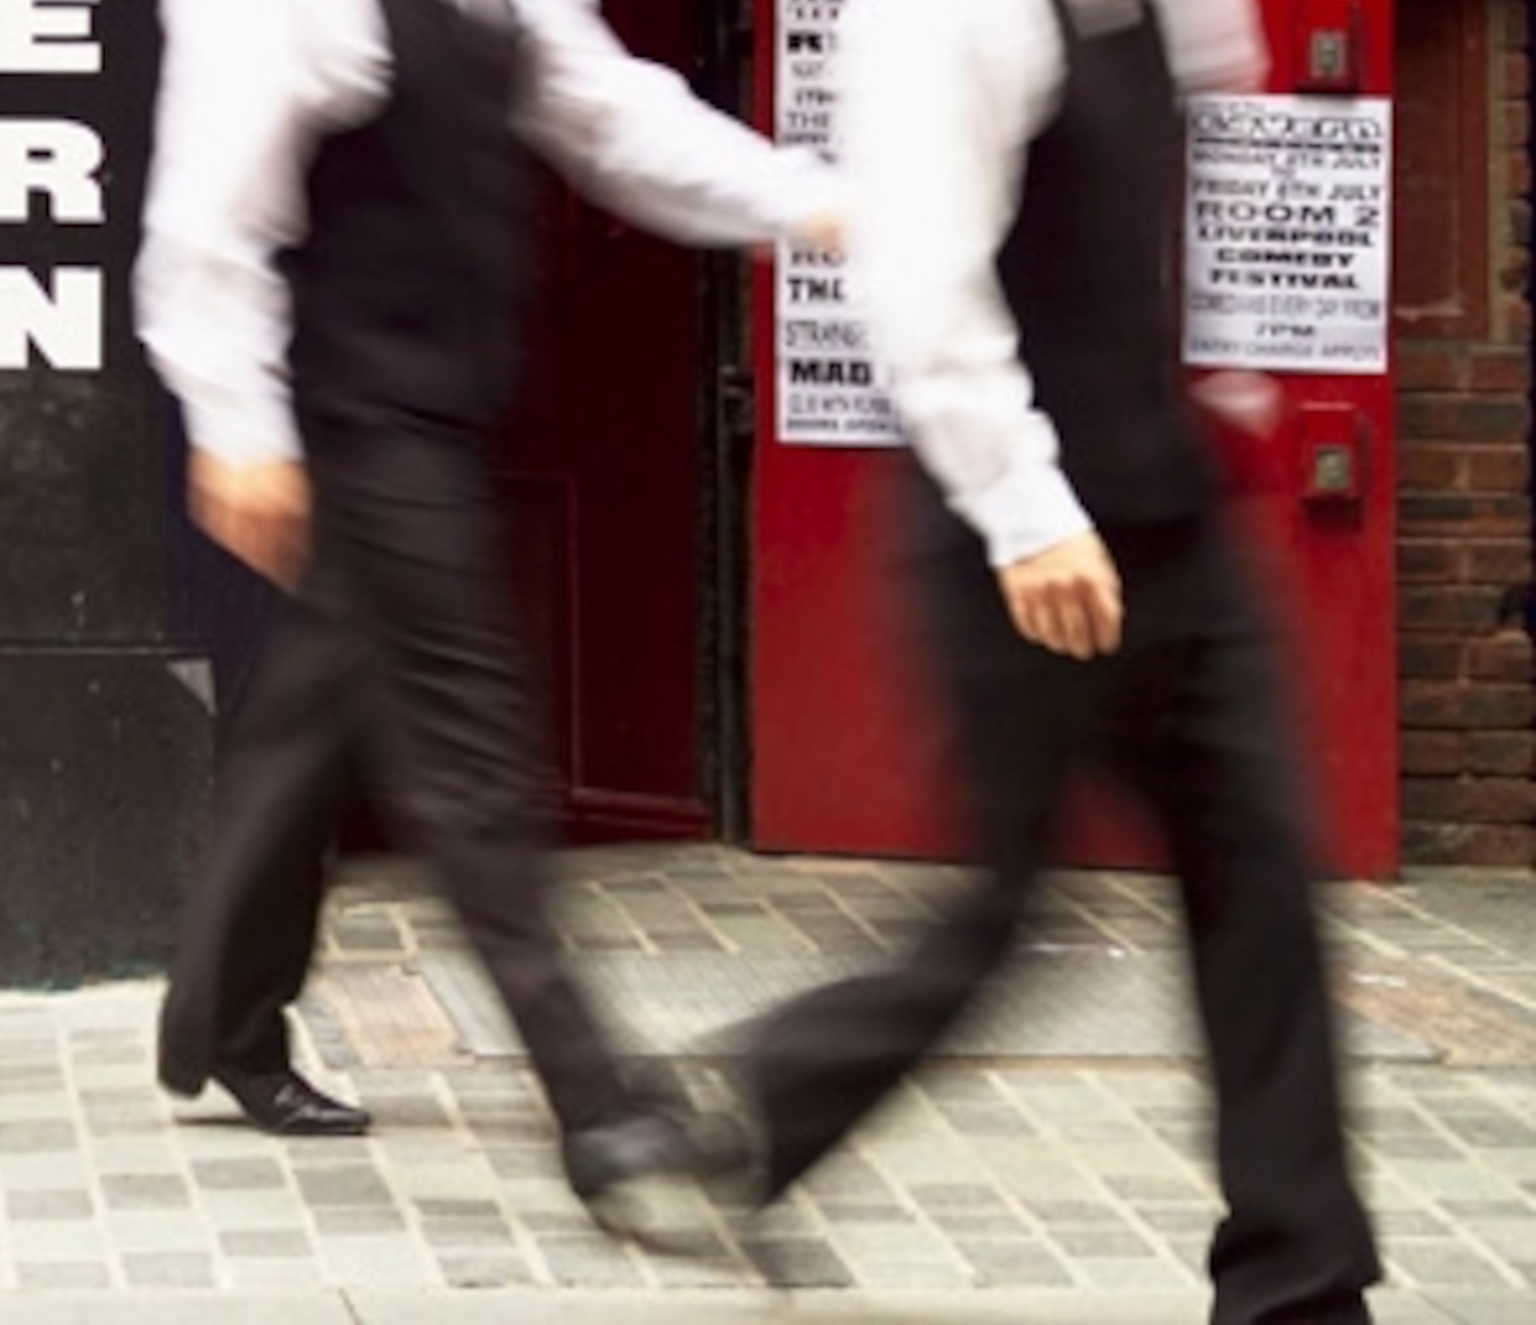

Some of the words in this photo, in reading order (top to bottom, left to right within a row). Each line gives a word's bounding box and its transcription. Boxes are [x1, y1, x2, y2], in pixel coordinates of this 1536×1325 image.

[1196, 200, 1336, 225] ROOM
[1354, 206, 1381, 228] 2
[1197, 226, 1374, 247] LIVERPOOL
[1216, 248, 1355, 268] COMEDY
[1210, 269, 1360, 289] FESTIVAL
